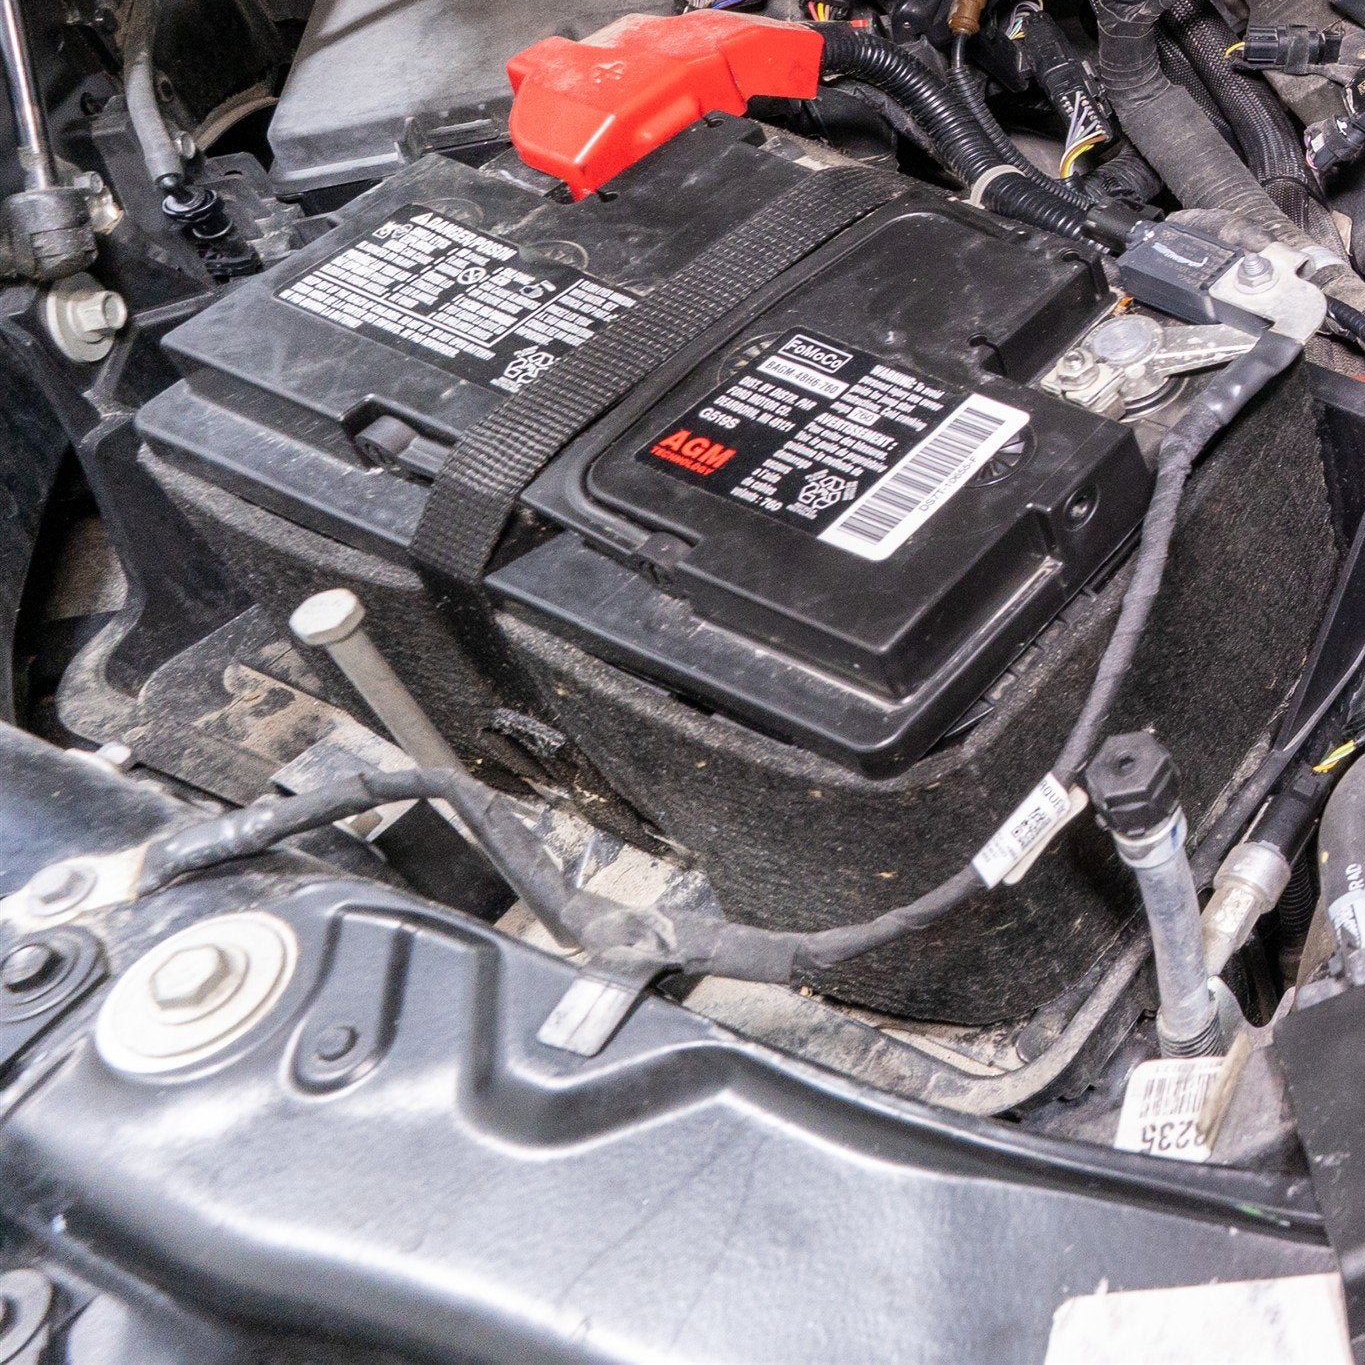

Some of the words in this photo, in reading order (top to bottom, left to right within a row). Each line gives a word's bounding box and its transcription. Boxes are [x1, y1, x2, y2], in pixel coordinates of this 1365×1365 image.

[784, 338, 844, 369] FoMoCo
[725, 385, 753, 401] FORD
[746, 393, 781, 412] MOTOR
[698, 407, 741, 429] G519S
[650, 443, 715, 476] TECHNOLOGY
[658, 428, 737, 471] AGM
